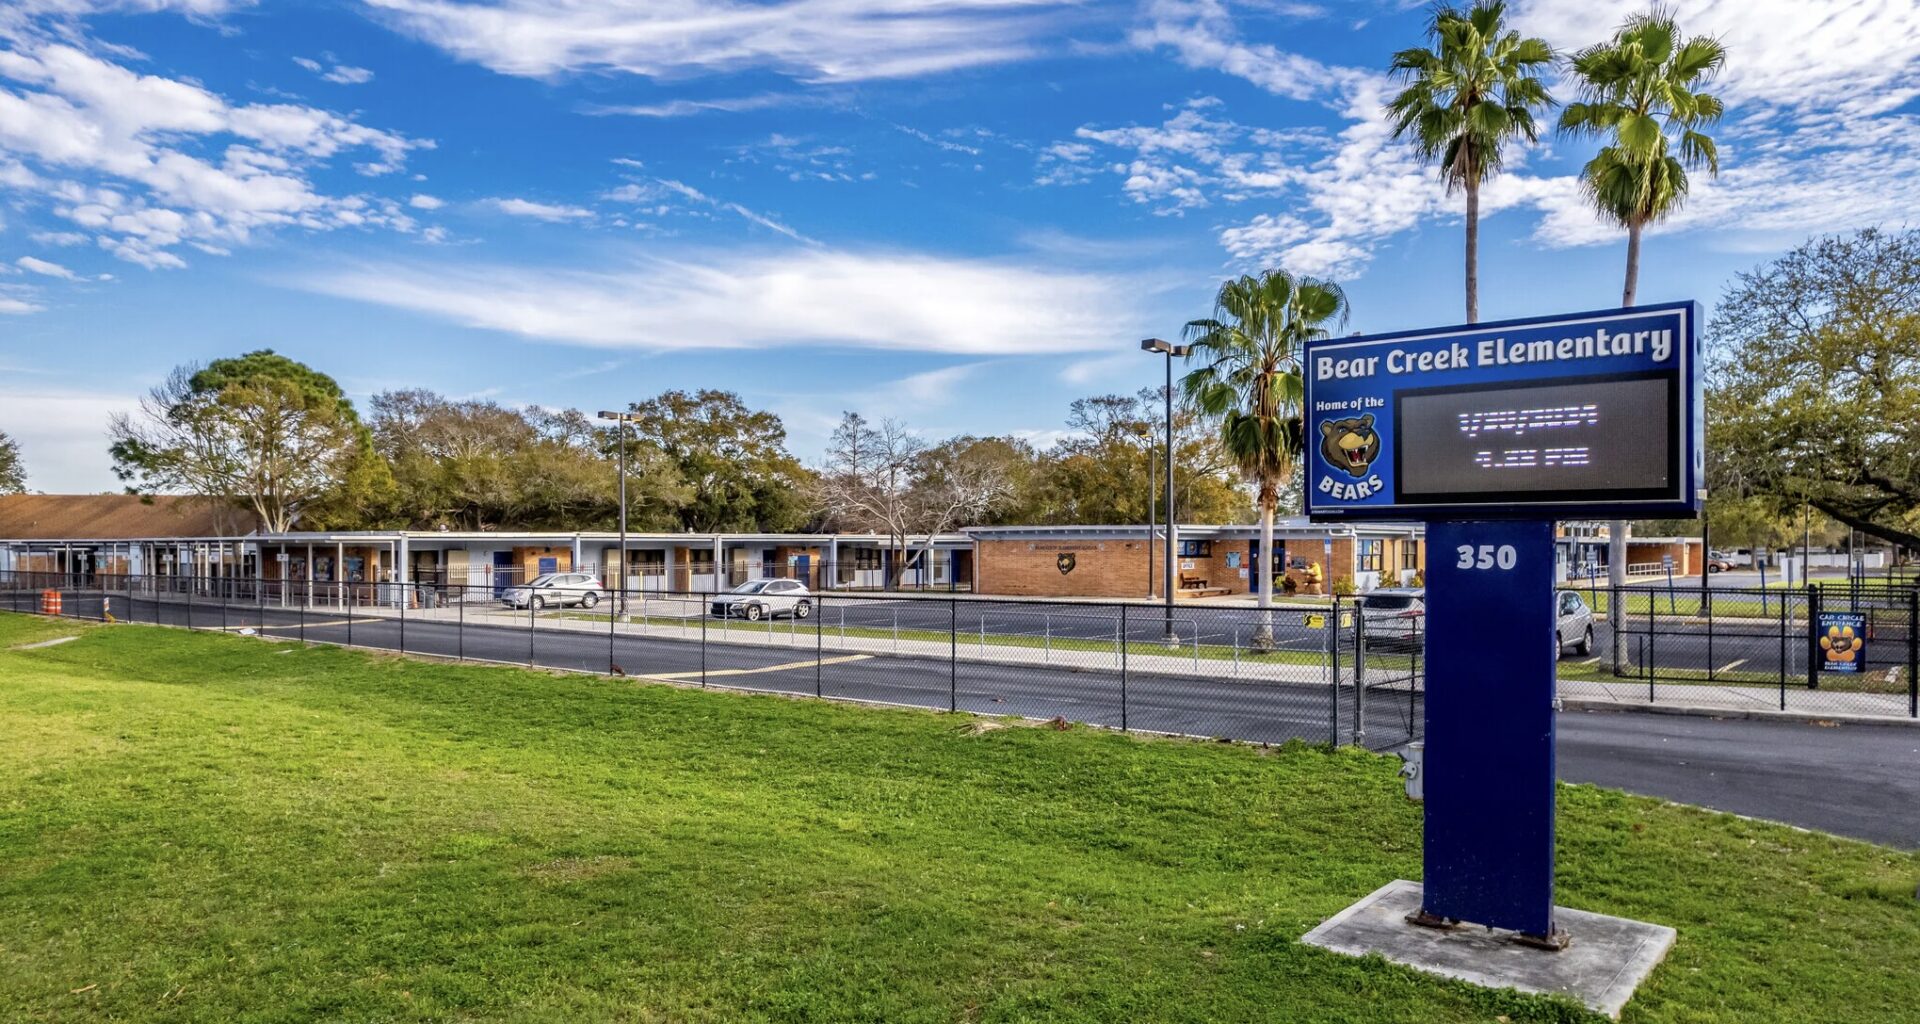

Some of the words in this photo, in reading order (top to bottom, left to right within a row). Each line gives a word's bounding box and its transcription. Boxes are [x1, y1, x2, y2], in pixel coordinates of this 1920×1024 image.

[1317, 356, 1379, 381] Bear
[1386, 342, 1470, 375] Creek
[1477, 328, 1672, 363] Elementary
[1316, 400, 1348, 411] Home
[1350, 397, 1363, 411] of
[1365, 396, 1385, 408] the
[1318, 474, 1384, 500] BEARS
[1456, 544, 1517, 570] 350
